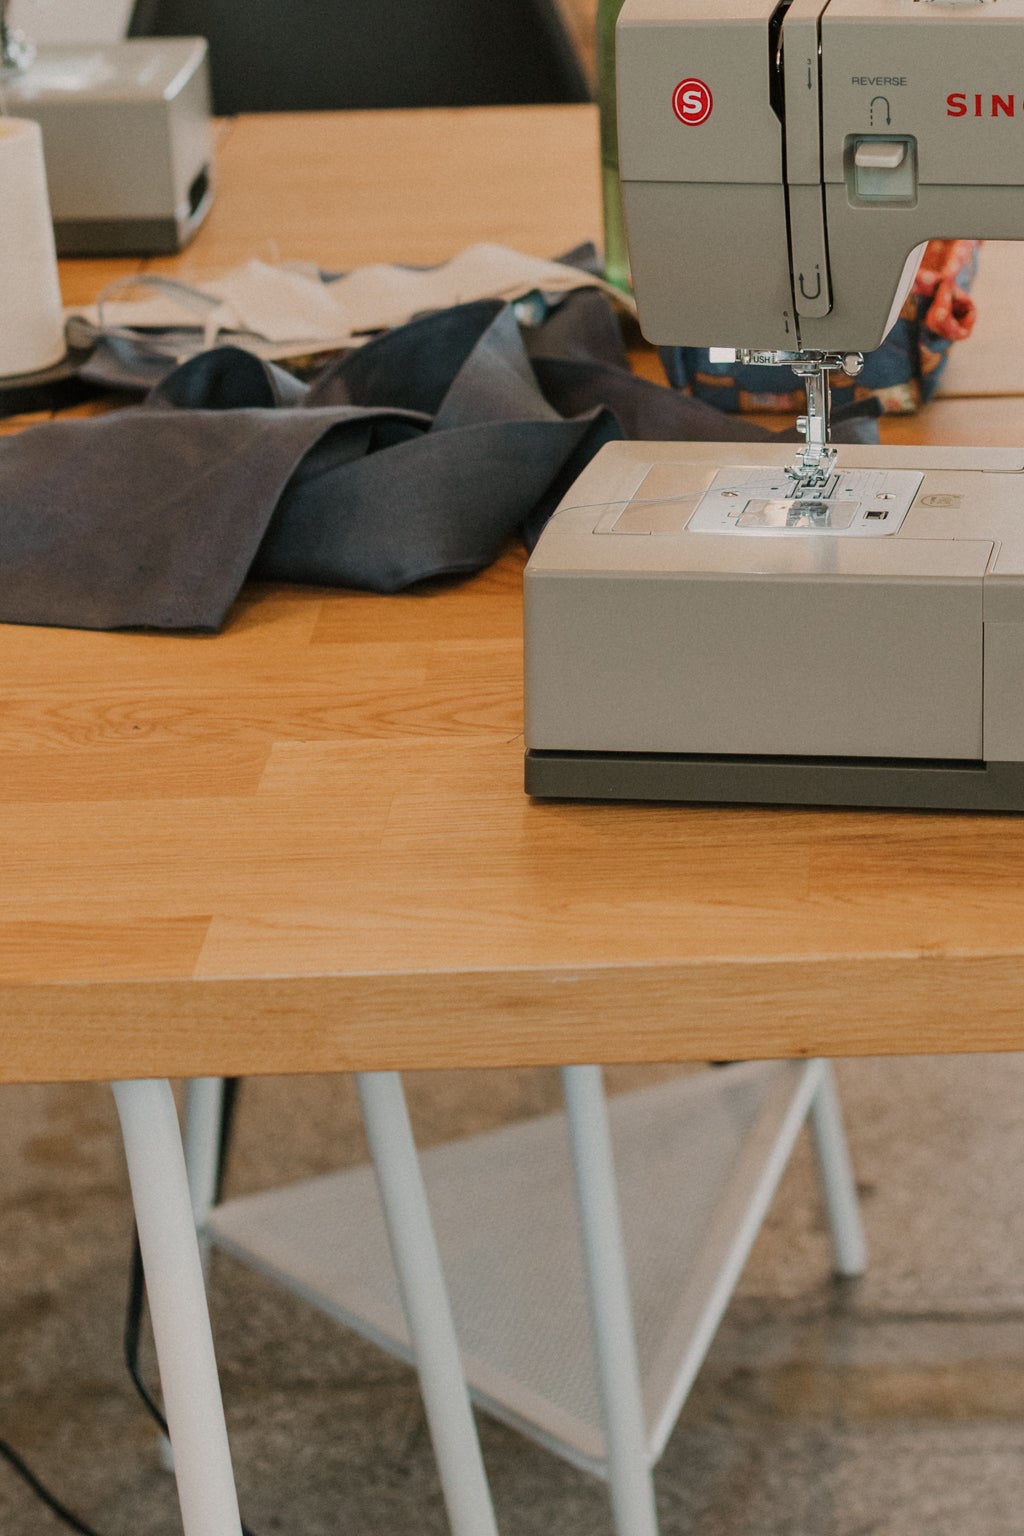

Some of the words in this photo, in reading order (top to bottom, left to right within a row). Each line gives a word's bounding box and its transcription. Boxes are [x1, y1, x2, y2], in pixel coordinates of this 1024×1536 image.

[851, 76, 908, 86] REVERSE
[682, 90, 702, 114] S
[752, 355, 771, 364] USH
